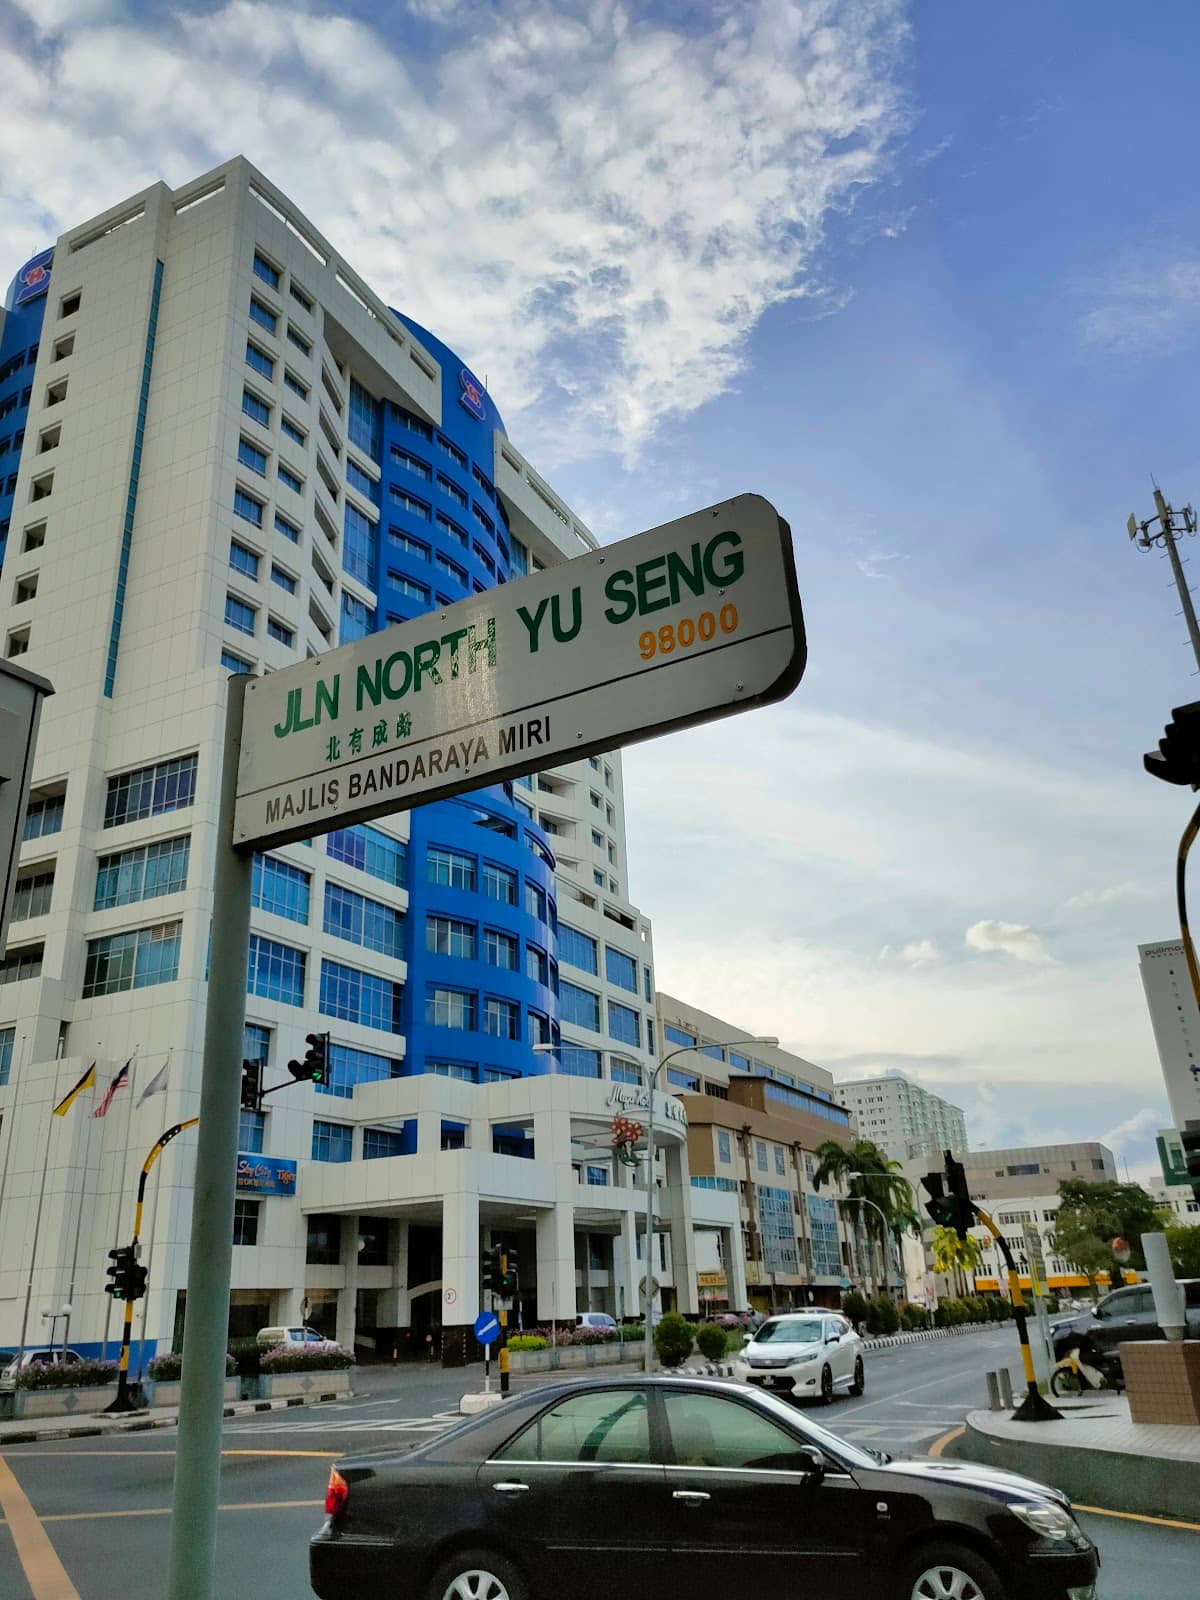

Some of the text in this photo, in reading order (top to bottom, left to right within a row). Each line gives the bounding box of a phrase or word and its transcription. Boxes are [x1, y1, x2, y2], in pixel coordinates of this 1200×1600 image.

[274, 530, 744, 739] JLN NORTH YU SENG
[638, 603, 738, 661] 98000
[265, 715, 551, 824] MAJLIS BANDARAYA MIRI
